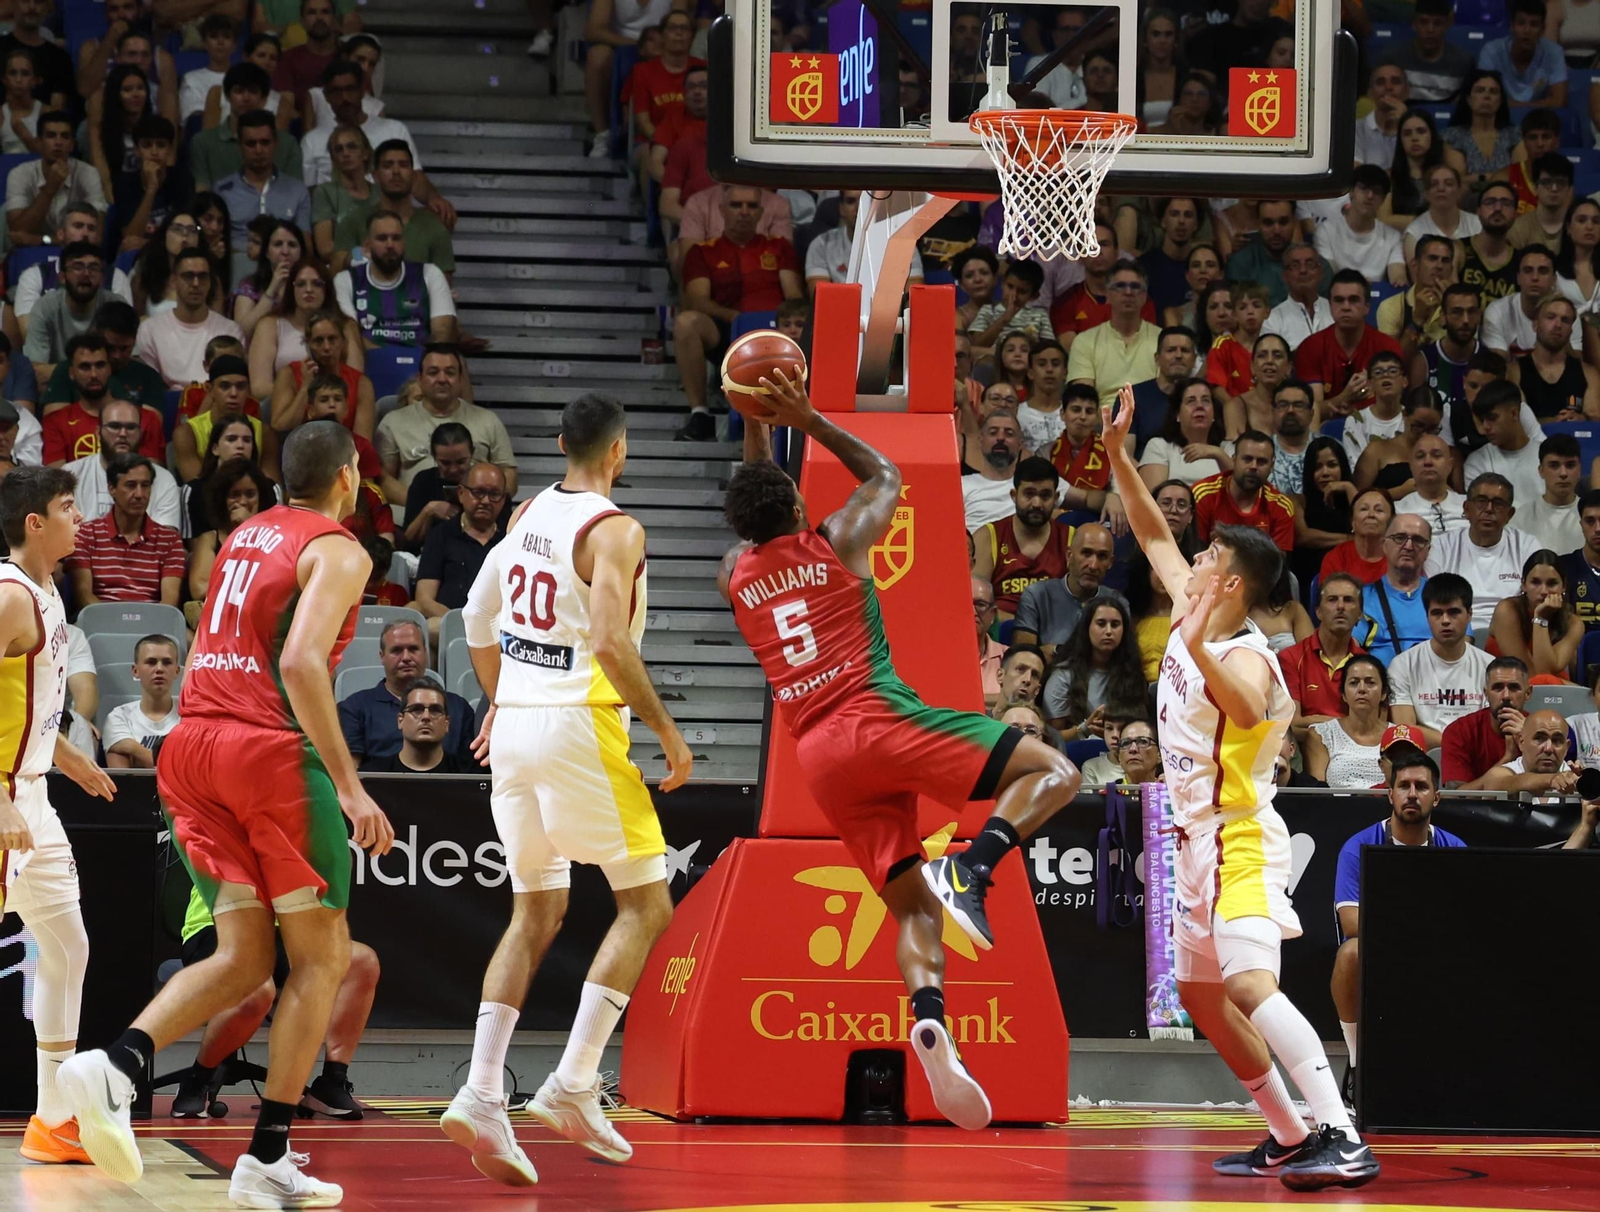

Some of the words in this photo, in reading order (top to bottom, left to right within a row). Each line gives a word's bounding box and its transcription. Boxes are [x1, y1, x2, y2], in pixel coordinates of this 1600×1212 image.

[838, 4, 874, 128] enfe
[895, 512, 910, 520] EB
[521, 532, 552, 559] ABALDE
[208, 559, 261, 637] 14
[508, 564, 558, 631] 20
[738, 563, 828, 609] WILLIAMS
[772, 599, 819, 666] 5
[507, 640, 568, 668] CaixaBank
[674, 672, 682, 682] 6
[1160, 703, 1167, 724] 4
[696, 731, 703, 741] 5
[1149, 823, 1158, 838] DE
[1150, 852, 1161, 927] BALONCESTO
[660, 932, 700, 1017] renfe
